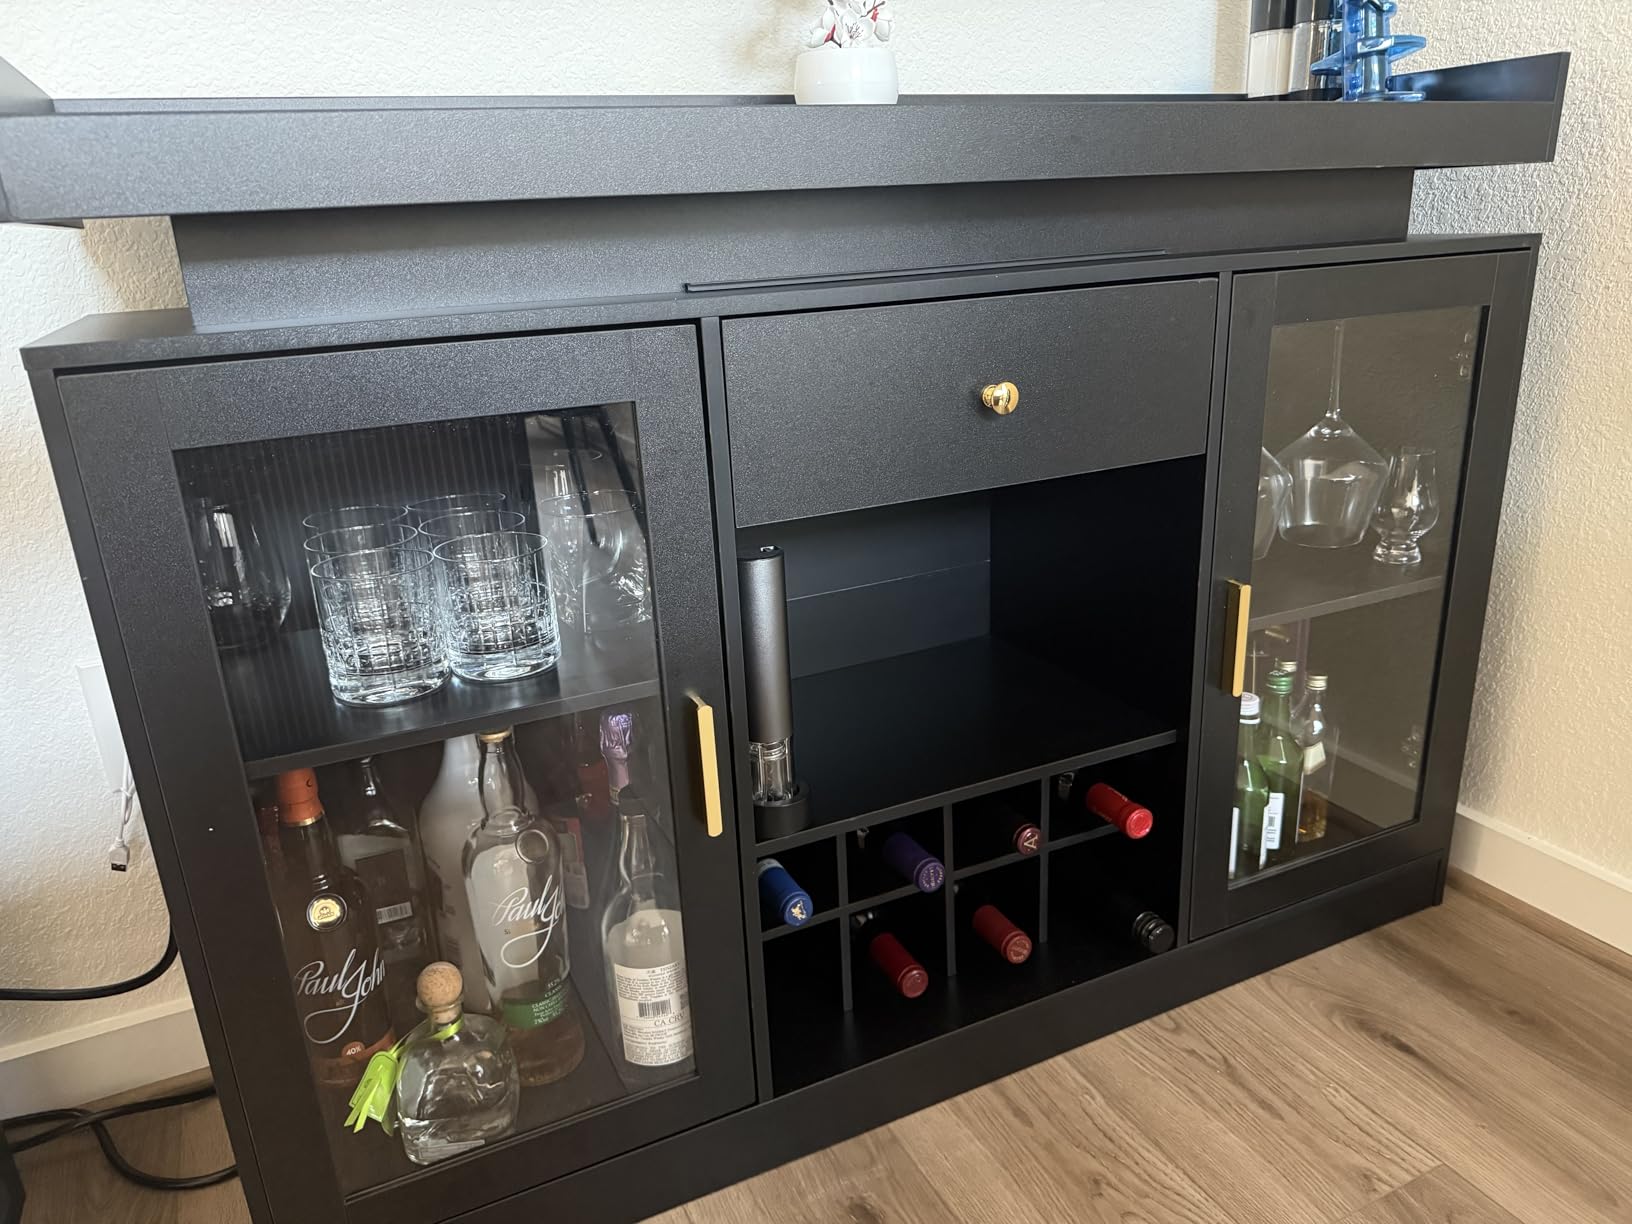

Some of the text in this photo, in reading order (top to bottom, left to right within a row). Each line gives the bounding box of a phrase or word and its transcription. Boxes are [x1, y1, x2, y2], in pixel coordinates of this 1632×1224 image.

[490, 874, 553, 926] Paul
[295, 948, 357, 995] Paul
[346, 1045, 362, 1056] 40%
